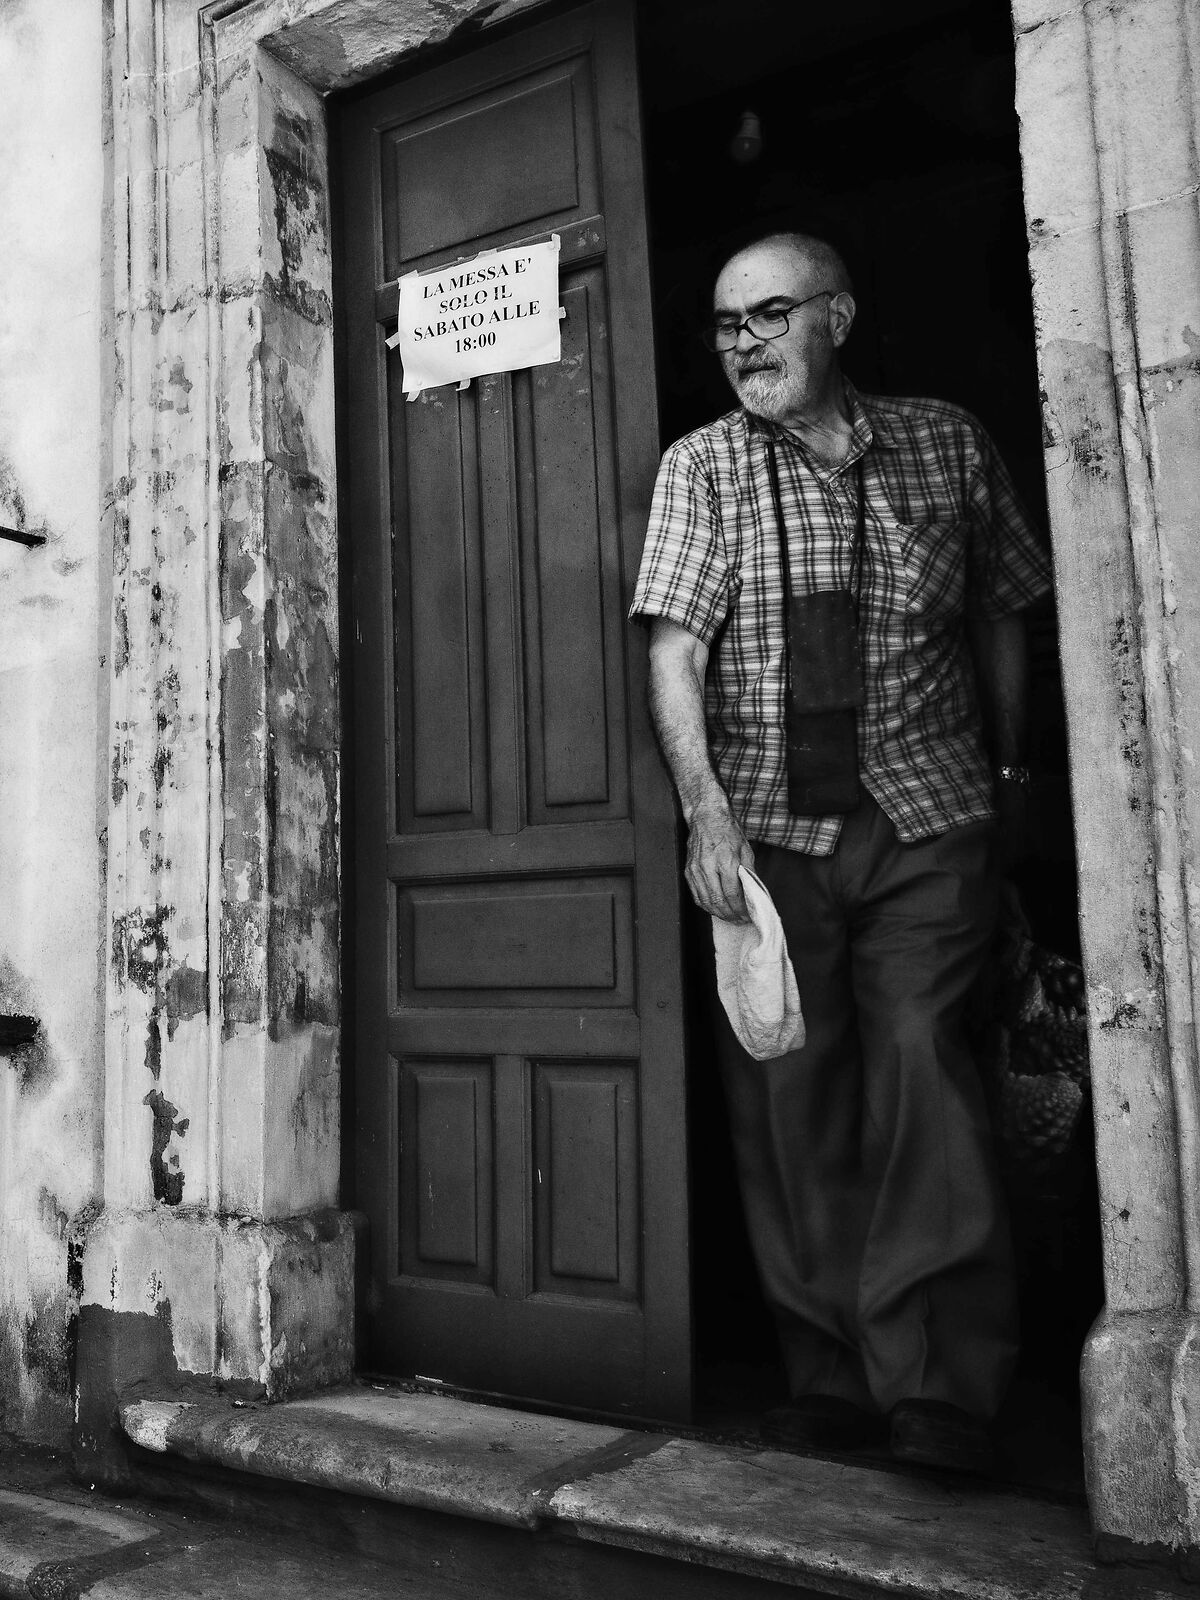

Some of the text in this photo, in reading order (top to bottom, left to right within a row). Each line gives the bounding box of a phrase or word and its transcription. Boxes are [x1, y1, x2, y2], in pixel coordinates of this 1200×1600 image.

[423, 257, 532, 299] LA MESSA E'
[439, 284, 513, 314] SOLO IL
[413, 300, 541, 342] SABATO ALLE
[455, 331, 497, 353] 18:00
